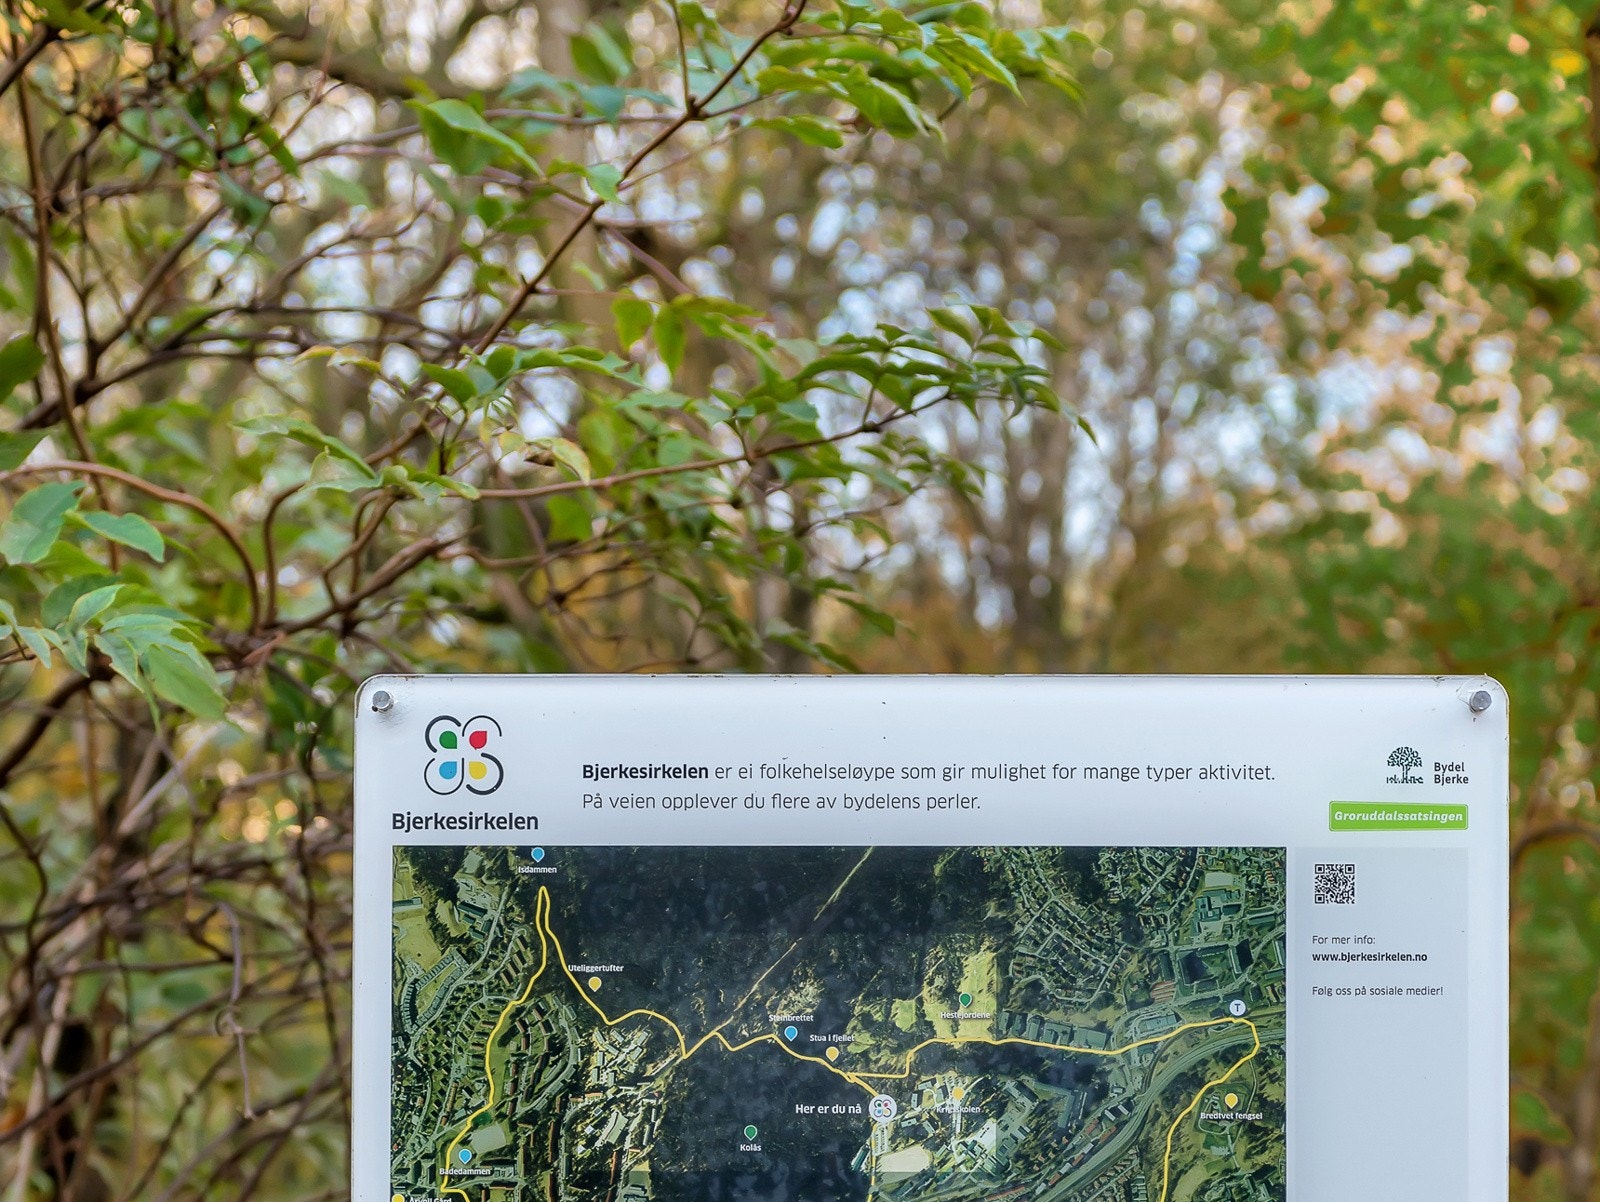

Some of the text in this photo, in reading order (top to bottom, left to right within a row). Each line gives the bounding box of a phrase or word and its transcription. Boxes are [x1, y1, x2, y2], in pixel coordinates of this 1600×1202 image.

[1434, 761, 1465, 773] Bydel
[583, 763, 1275, 782] Bjerkesirkelen er ei folkehelseløype som gir mulighet for mange typer aktivitet.
[1434, 773, 1469, 786] Bjerke
[583, 793, 980, 811] På veien opplever du flere av bydelens perler.
[392, 811, 538, 833] Bjerkesirkelen
[1334, 811, 1463, 824] Groruddalssatsingen
[518, 865, 557, 873] Isdammen
[1312, 935, 1375, 945] For mer info:
[1312, 952, 1428, 963] www.bjerkesirkelen.no
[568, 964, 624, 973] Uteliggertufter
[1312, 986, 1443, 997] Følg oss på sosiale medier!
[1234, 1003, 1241, 1012] T
[768, 1014, 814, 1022] Steinbrettet
[940, 1011, 991, 1020] Hestejordene
[809, 1034, 827, 1042] Stua
[832, 1034, 855, 1043] fjellet
[795, 1103, 862, 1114] Her er du nå
[1200, 1112, 1263, 1121] Bredtvet fengsel
[740, 1143, 762, 1152] Kolås
